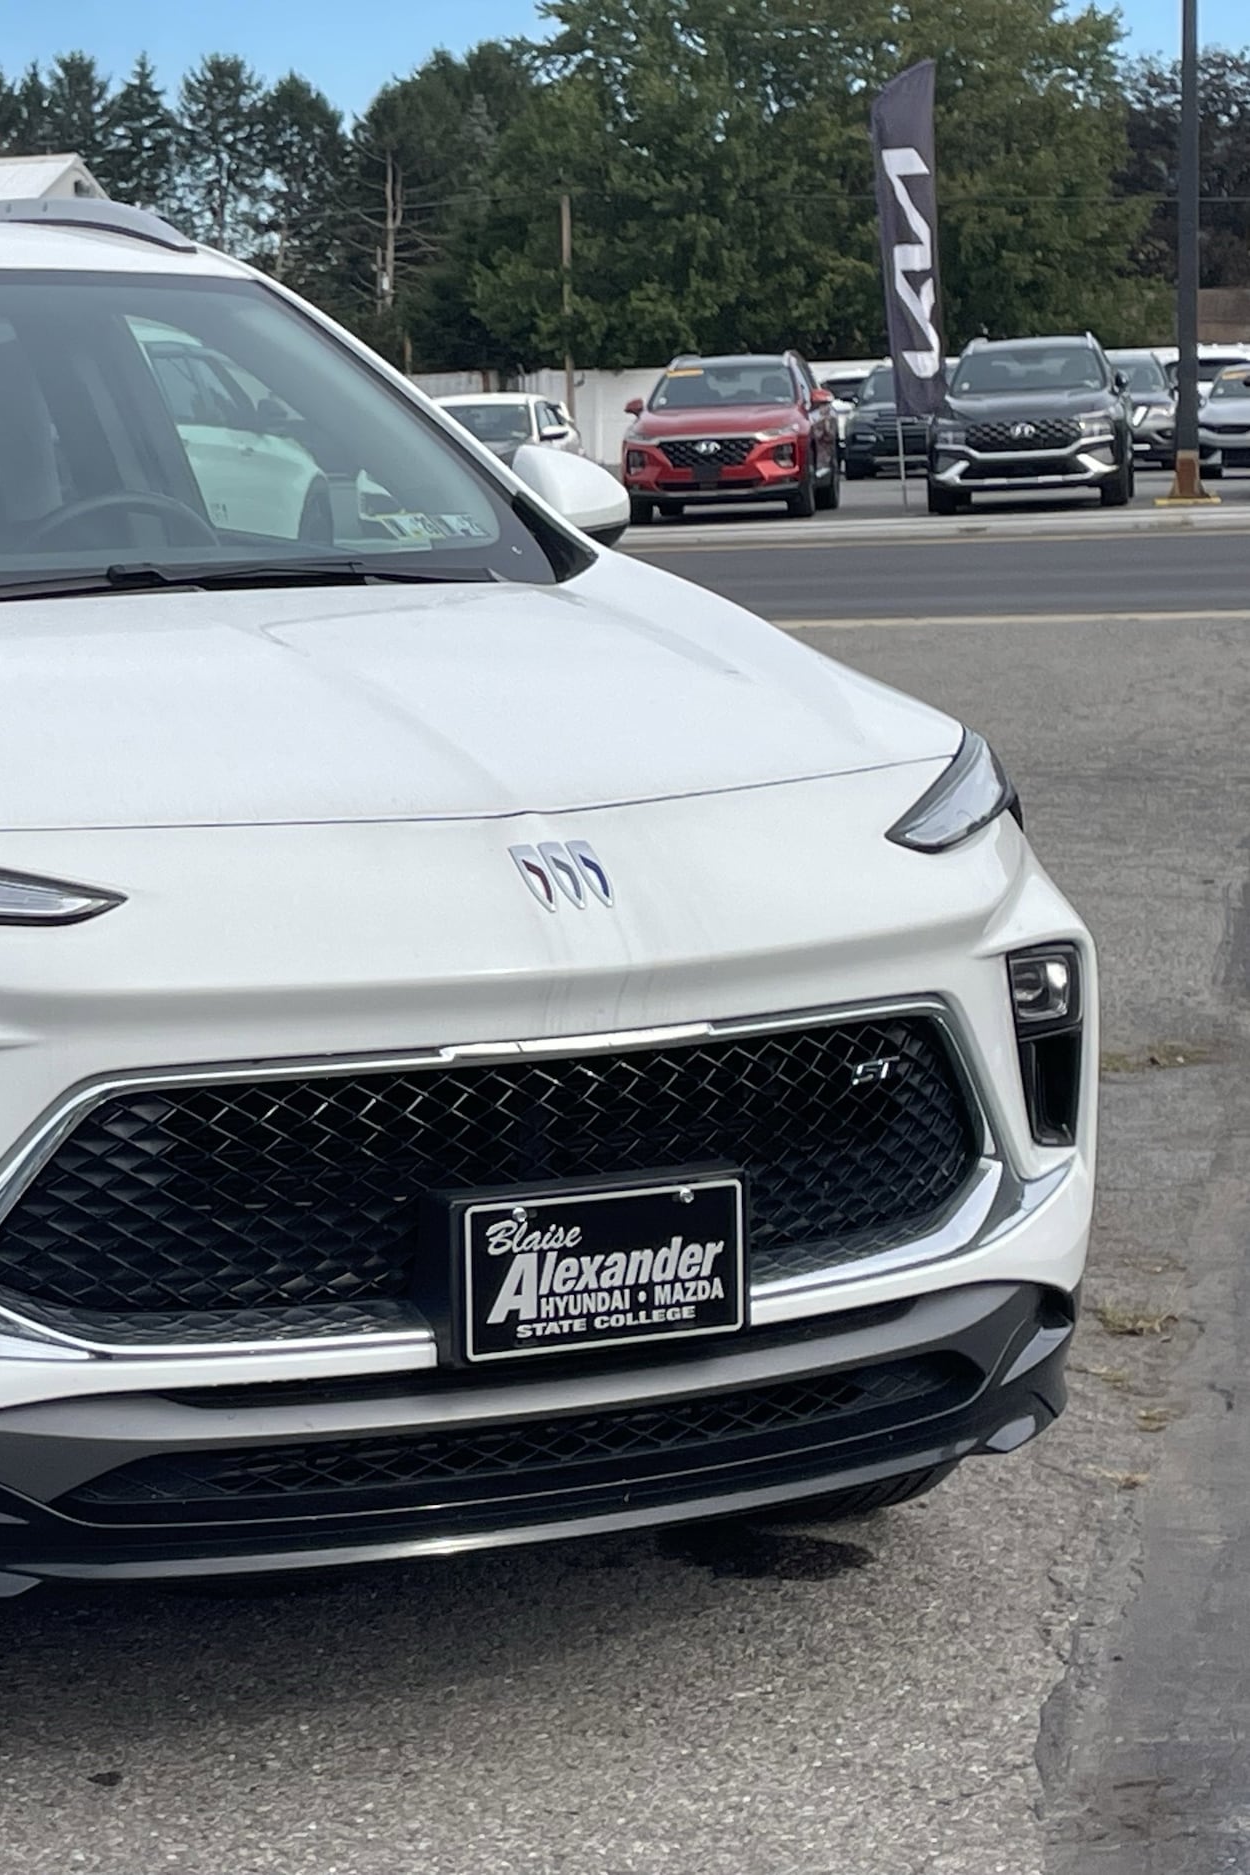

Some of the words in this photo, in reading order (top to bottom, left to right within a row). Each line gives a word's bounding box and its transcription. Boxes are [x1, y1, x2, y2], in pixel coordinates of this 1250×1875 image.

[485, 1219, 583, 1256] Blaise
[485, 1235, 725, 1325] Alexander
[540, 1287, 631, 1319] HYUNDAI
[653, 1276, 725, 1306] MAZDA
[515, 1320, 588, 1339] STATE
[593, 1304, 697, 1330] COLLEGE
